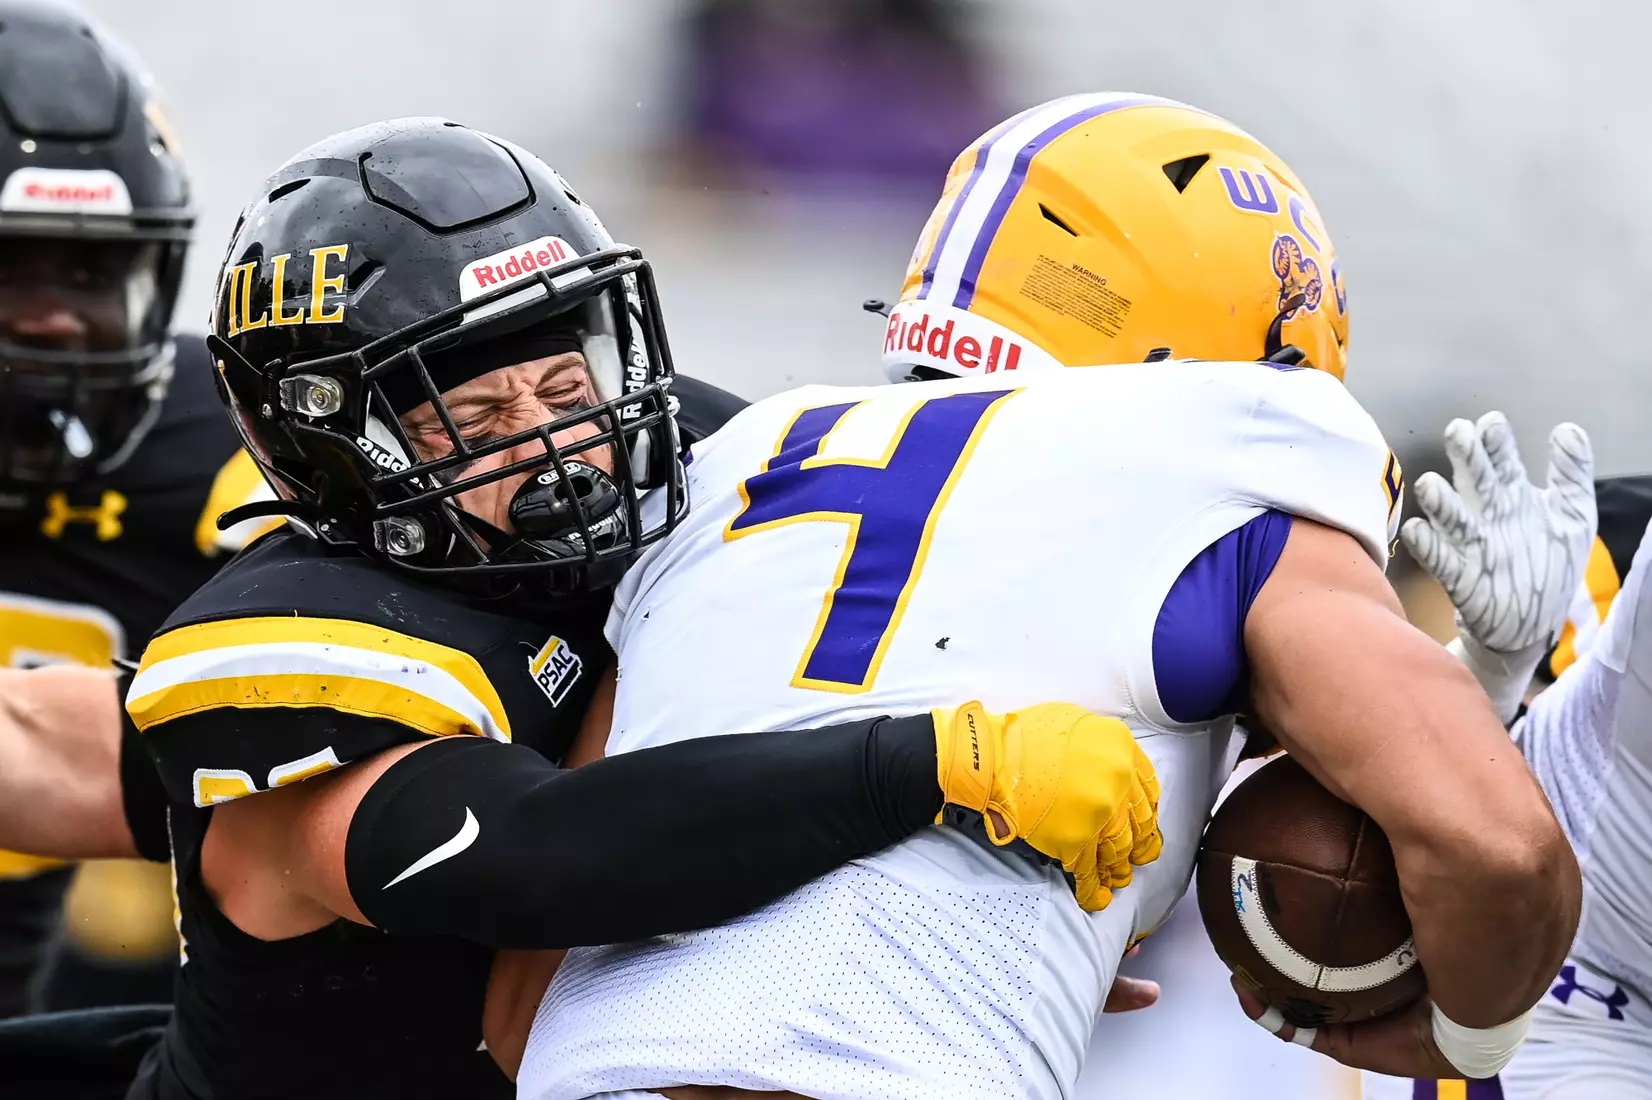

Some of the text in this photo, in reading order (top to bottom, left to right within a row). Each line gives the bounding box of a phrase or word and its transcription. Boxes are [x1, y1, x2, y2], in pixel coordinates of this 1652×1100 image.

[472, 240, 567, 289] Riddell
[1072, 263, 1108, 287] WARNING
[884, 312, 1022, 375] Riddell
[722, 386, 1028, 694] 4
[537, 644, 574, 694] PSAC
[967, 712, 980, 772] CUTTERS
